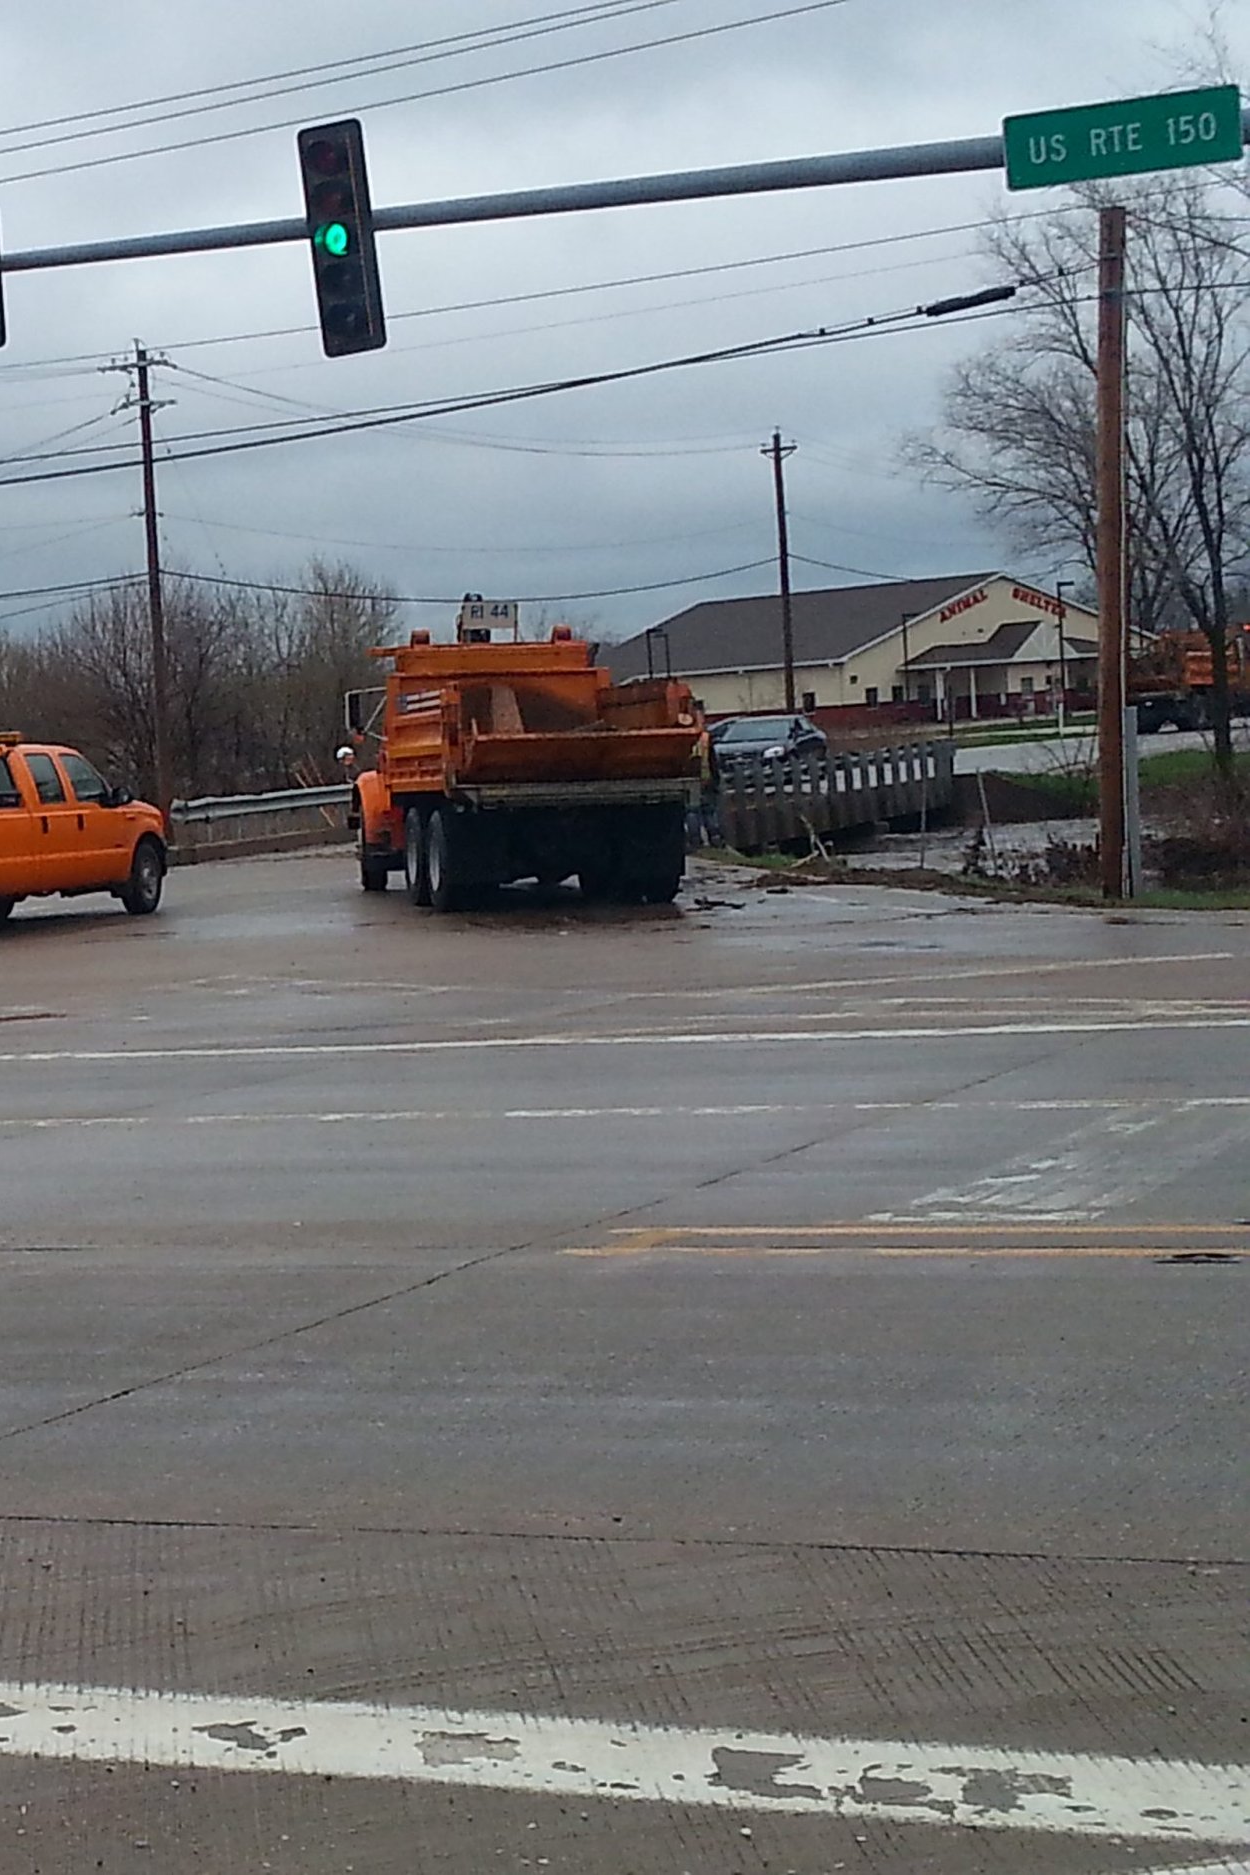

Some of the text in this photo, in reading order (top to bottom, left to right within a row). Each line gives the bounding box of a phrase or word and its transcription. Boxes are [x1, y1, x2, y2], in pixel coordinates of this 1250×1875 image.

[1029, 112, 1216, 163] US RTE 150
[490, 604, 508, 619] 44
[940, 587, 1066, 623] ANIMAL SHELTER
